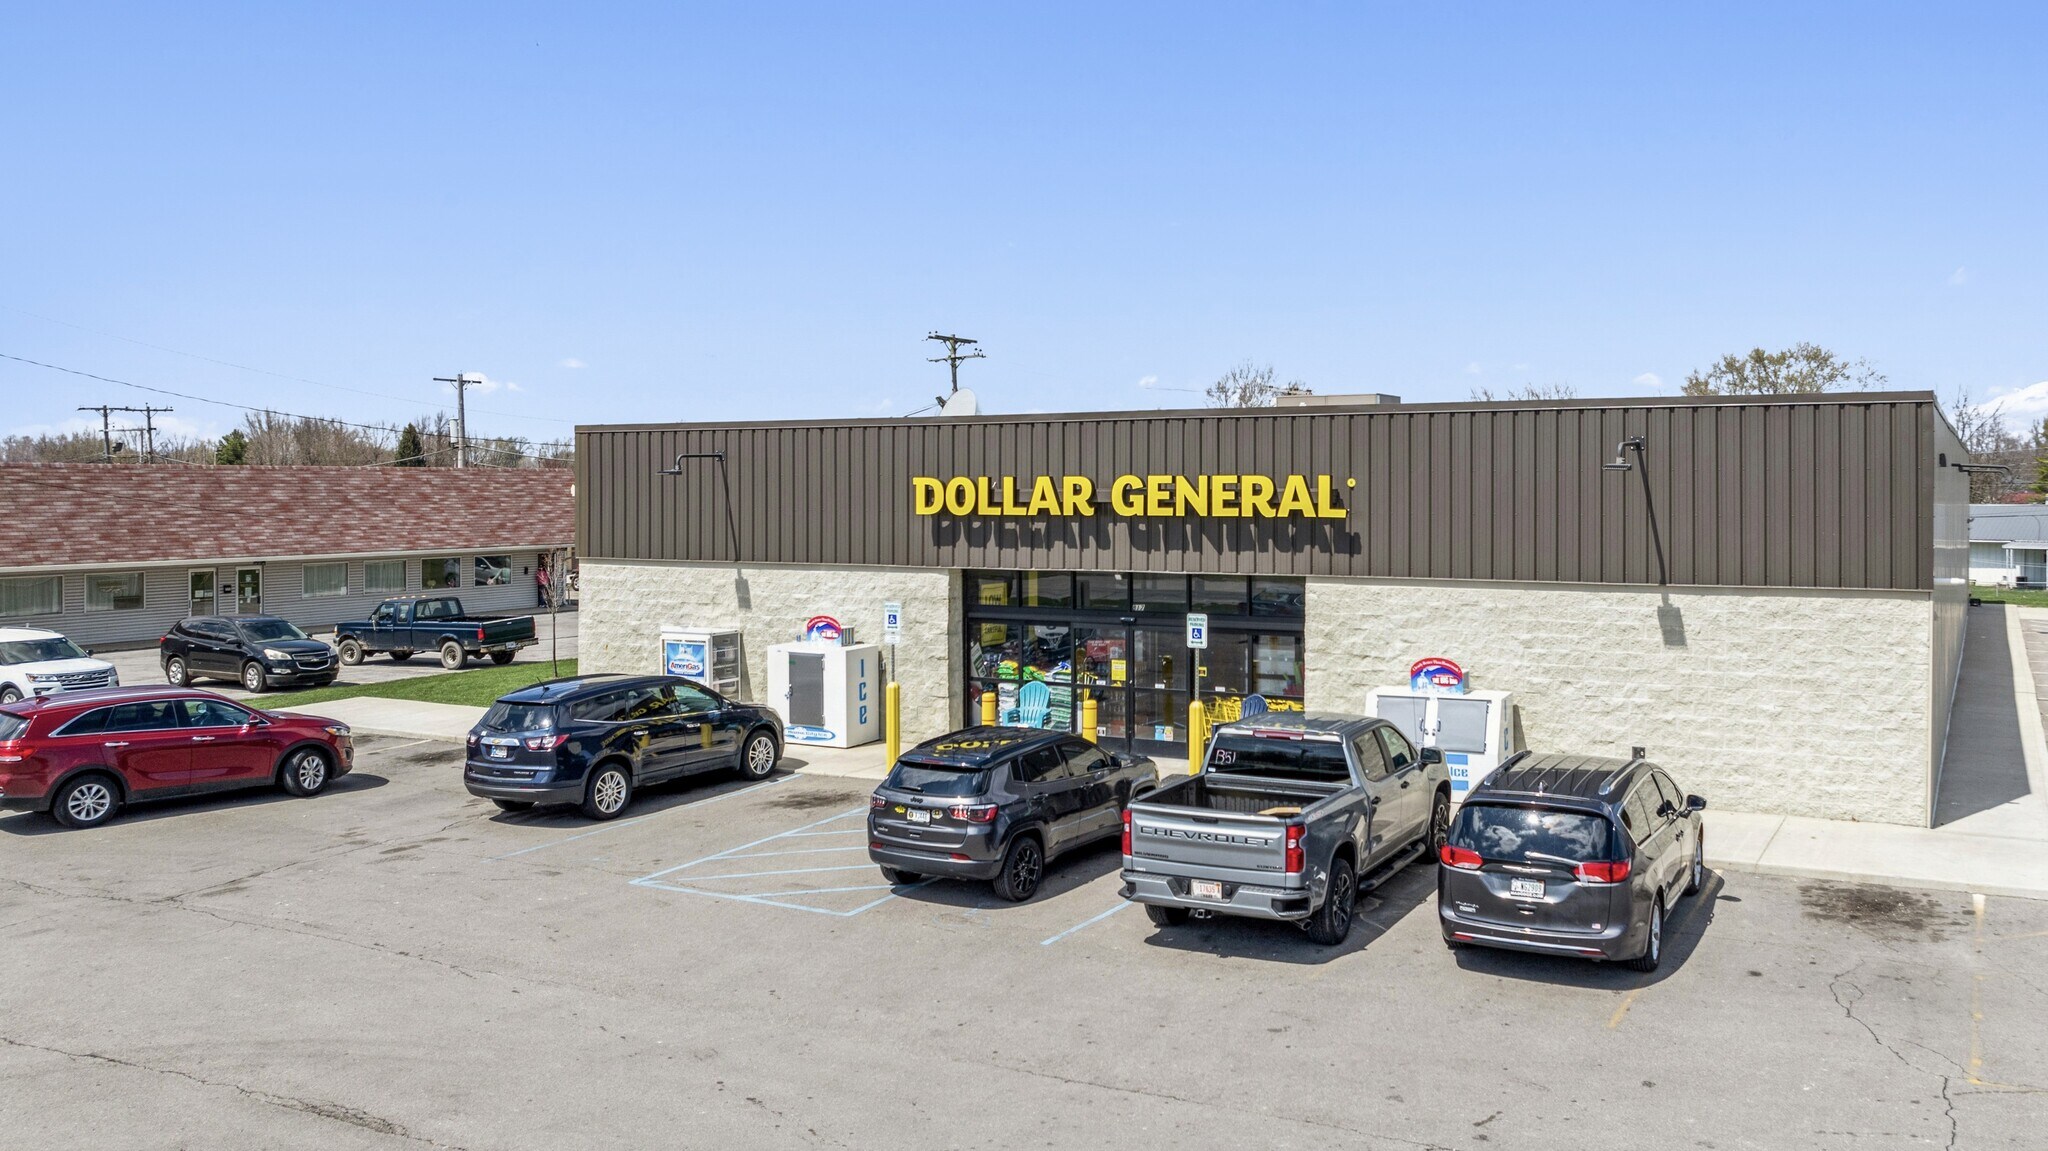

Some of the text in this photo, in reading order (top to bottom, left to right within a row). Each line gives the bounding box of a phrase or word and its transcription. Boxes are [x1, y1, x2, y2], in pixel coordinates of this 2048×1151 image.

[913, 475, 1348, 519] DOLLAR GENERAL
[670, 661, 701, 671] AmeriGas
[1450, 766, 1468, 777] Ice
[910, 796, 923, 804] Jeep
[1140, 826, 1274, 848] CHEVROLET
